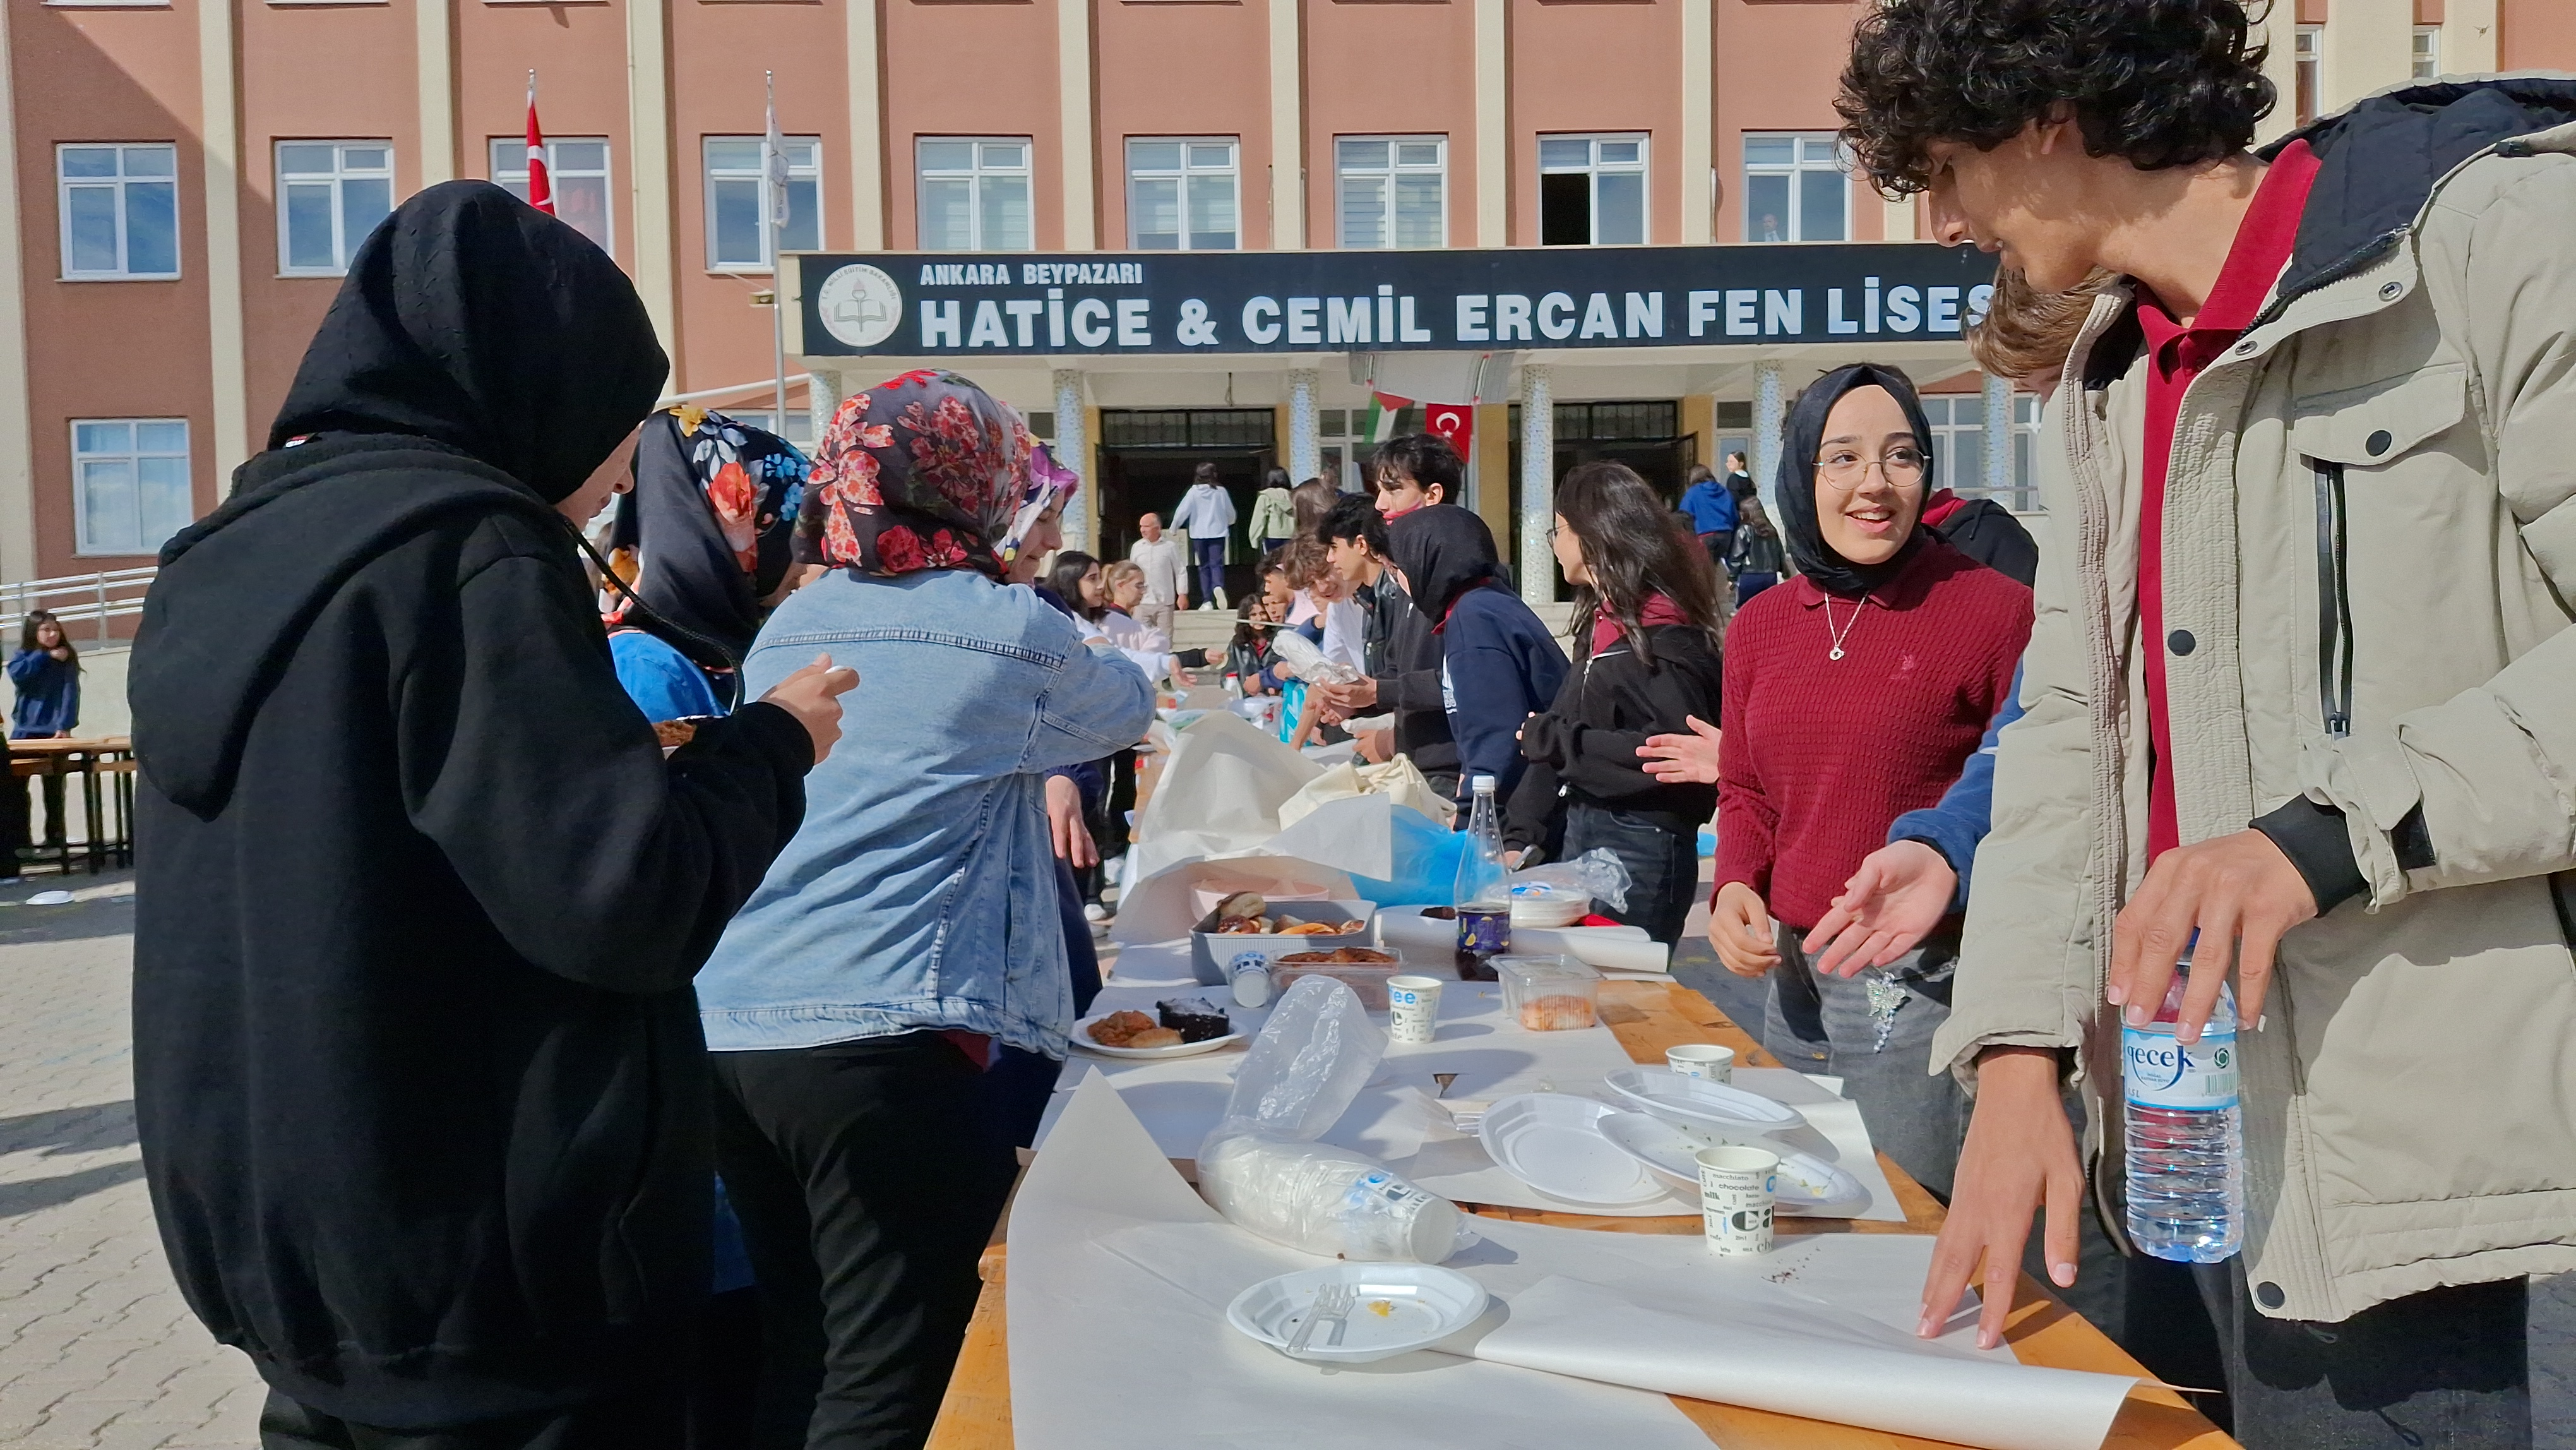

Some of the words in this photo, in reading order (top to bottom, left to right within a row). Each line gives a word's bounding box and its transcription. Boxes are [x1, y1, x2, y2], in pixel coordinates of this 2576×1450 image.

[921, 263, 1011, 285] ANKARA
[1023, 263, 1143, 285] BEYPAZARI
[921, 287, 1152, 348] HATİCE
[1176, 298, 1220, 347] &
[1242, 284, 1431, 345] CEMİL
[1457, 292, 1664, 342] ERCAN
[1688, 289, 1802, 337] FEN
[1827, 275, 1994, 335] LİSES
[1718, 1183, 1760, 1191] chocolate
[1704, 1191, 1720, 1201] milk
